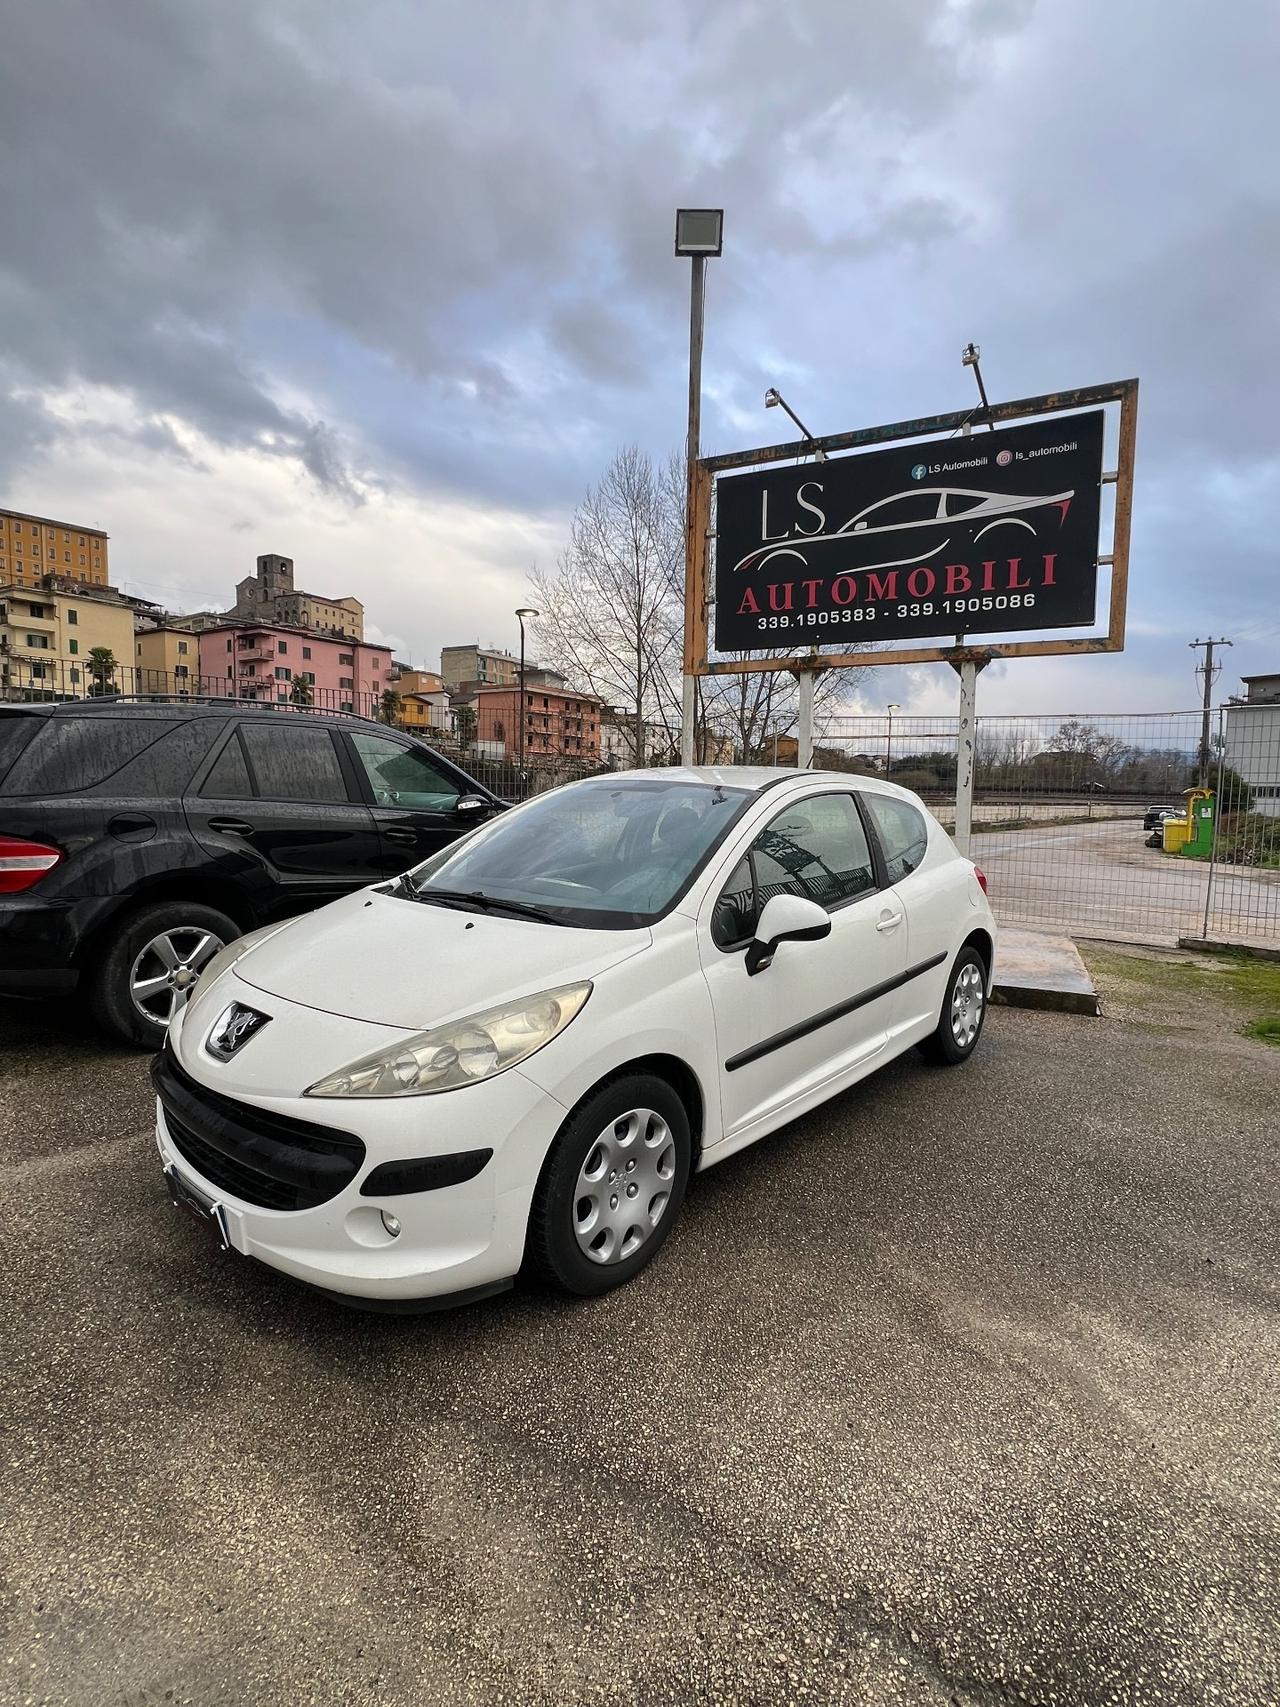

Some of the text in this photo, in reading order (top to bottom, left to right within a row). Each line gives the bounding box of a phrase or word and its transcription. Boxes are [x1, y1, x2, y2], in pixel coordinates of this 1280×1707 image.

[1015, 441, 1078, 461] ls_automobili
[928, 456, 988, 474] LS Automobili
[736, 554, 1057, 614] AUTOMOBILI
[758, 608, 876, 629] 339.1905383
[897, 594, 1036, 618] 339.1905086
